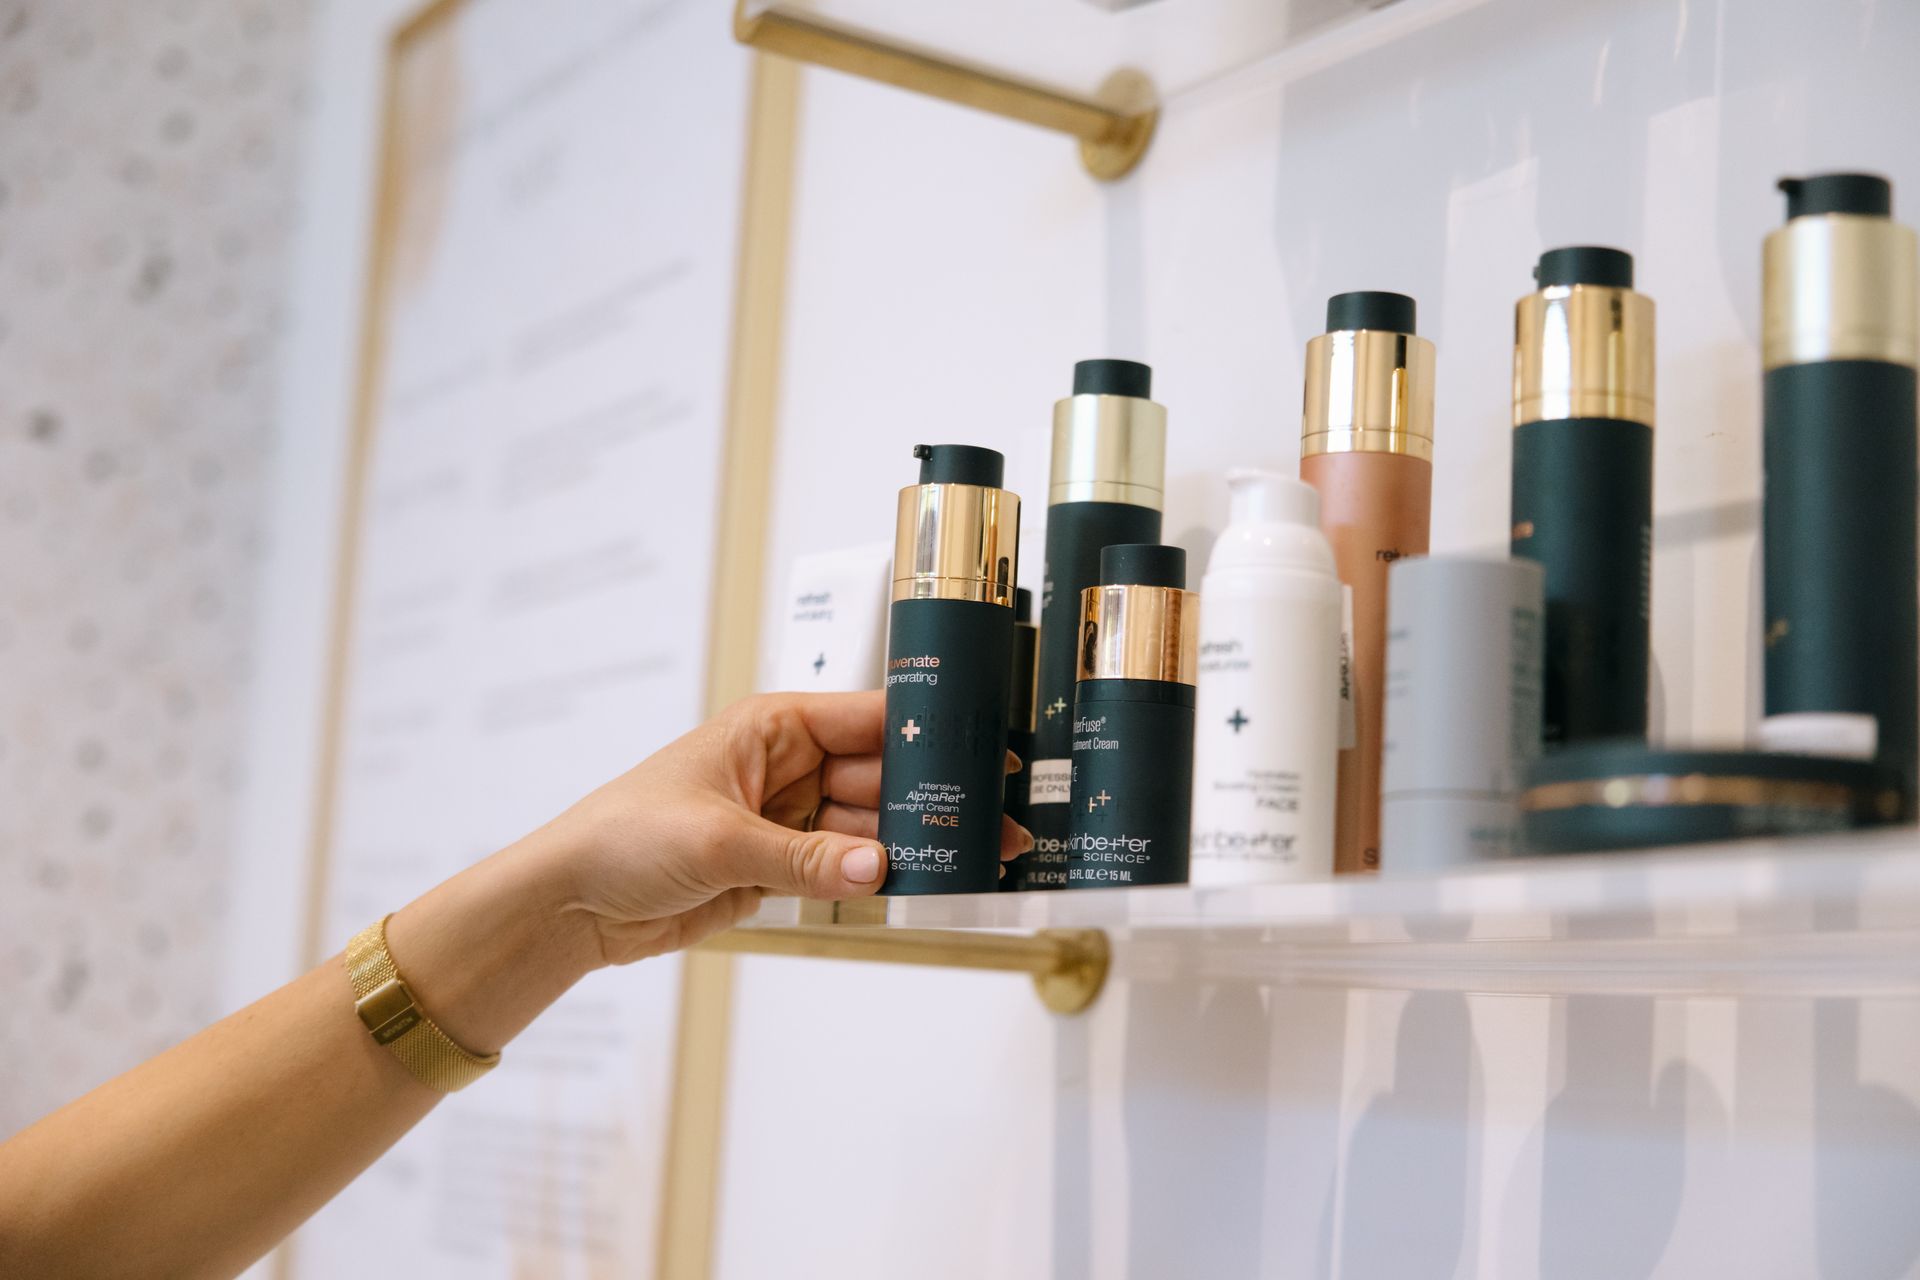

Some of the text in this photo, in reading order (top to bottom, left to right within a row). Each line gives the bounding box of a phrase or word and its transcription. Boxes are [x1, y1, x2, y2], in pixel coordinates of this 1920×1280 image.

[1093, 737, 1119, 750] Cream
[918, 782, 961, 792] Intensive
[887, 802, 960, 813] Overnight Cream
[922, 814, 960, 827] FACE
[1109, 870, 1119, 881] 15
[1120, 870, 1133, 882] ML
